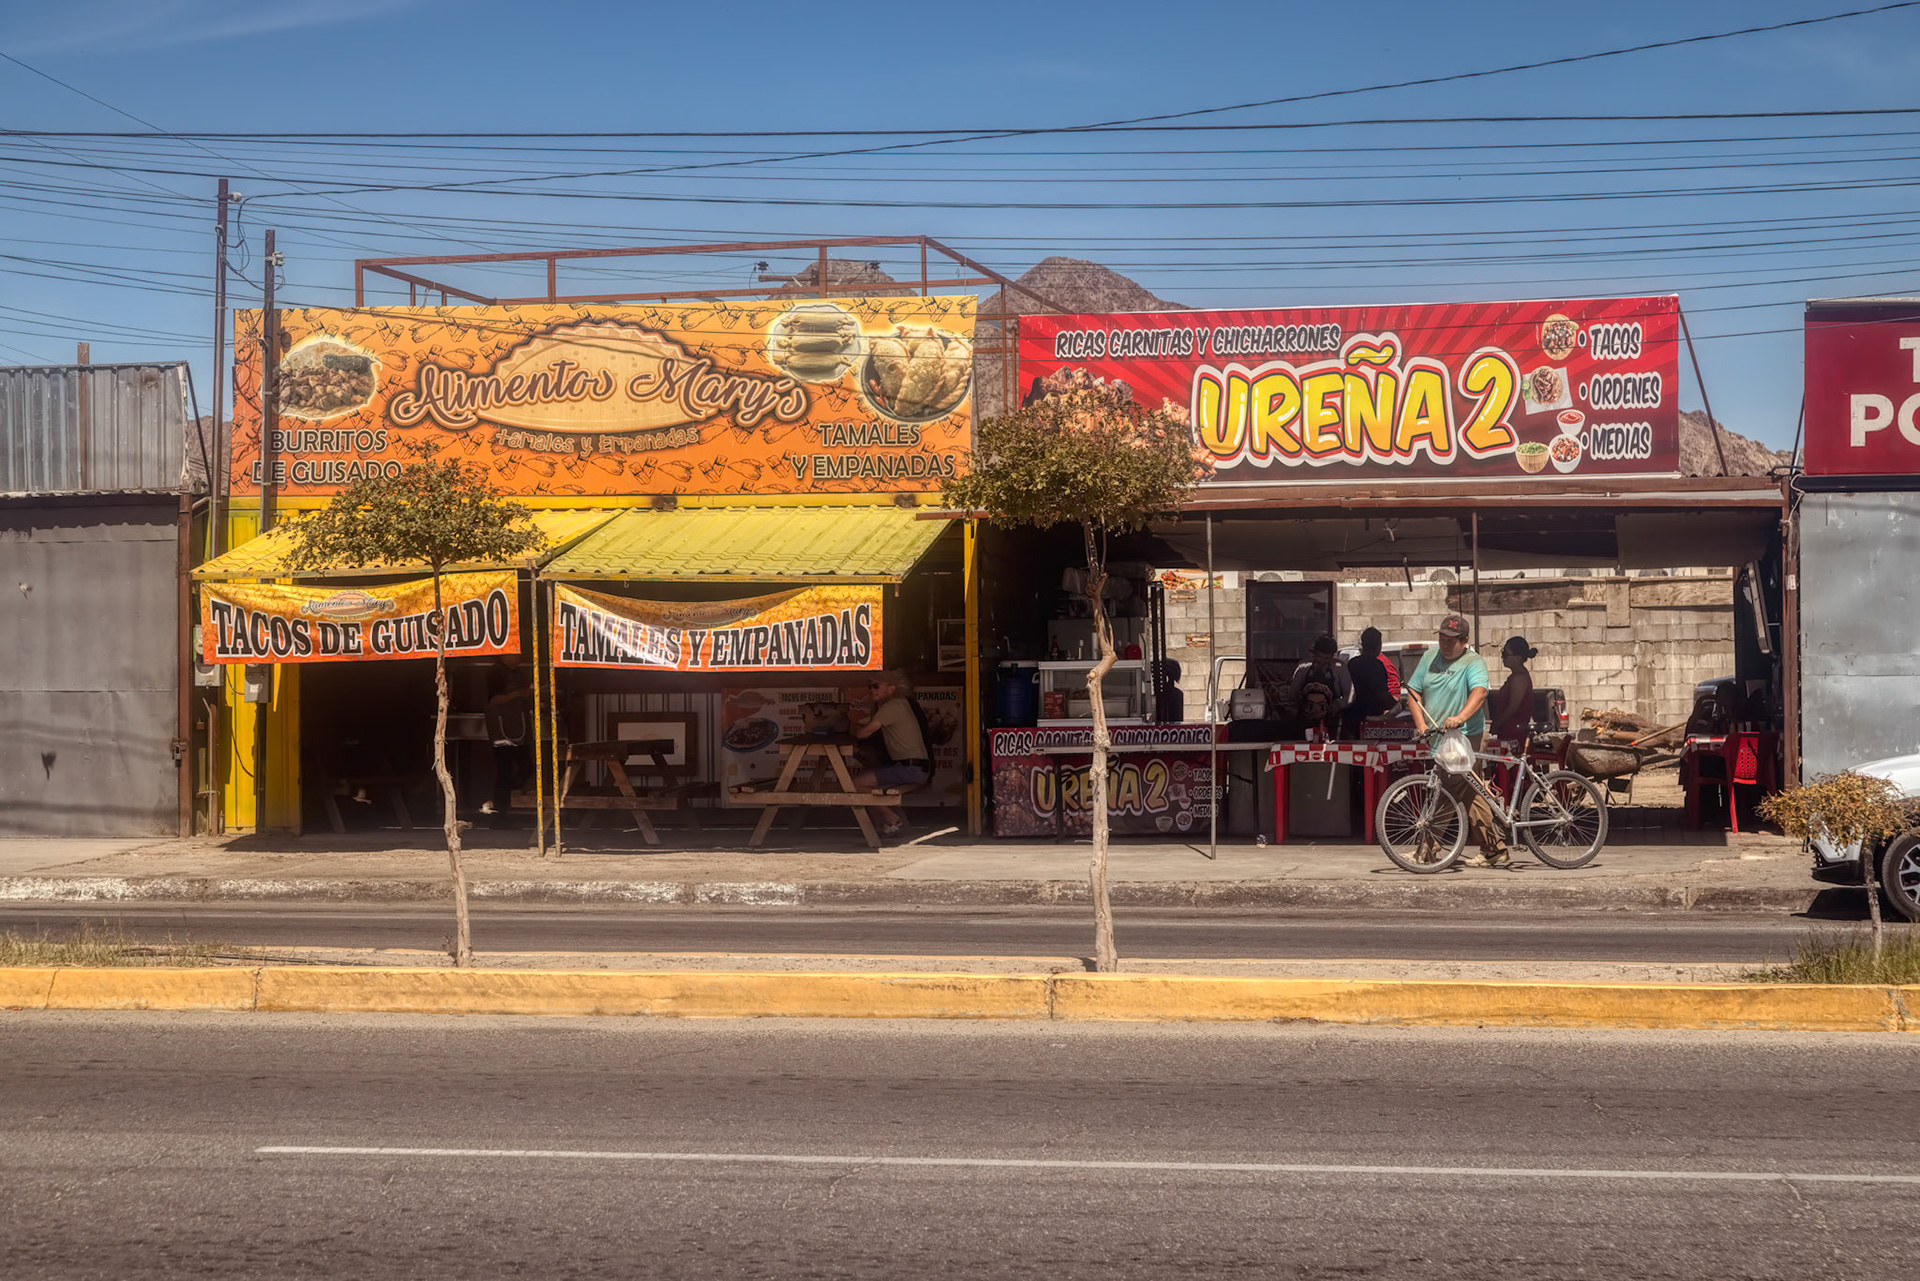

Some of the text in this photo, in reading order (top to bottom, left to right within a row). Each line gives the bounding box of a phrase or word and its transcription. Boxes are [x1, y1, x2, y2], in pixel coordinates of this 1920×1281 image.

[1055, 323, 1342, 359] RICAS CARNITAS Y CHICHARRONES
[1590, 322, 1643, 360] TACOS
[391, 357, 807, 428] Alimentos Mary's
[1194, 336, 1521, 466] UREÑA 2
[1589, 371, 1662, 410] ORDENES
[271, 429, 387, 453] BURRITOS
[496, 427, 699, 457] tamales y Empanadas
[819, 423, 921, 447] TAMALES
[1590, 421, 1653, 460] MEDIAS
[291, 459, 403, 484] GUISADO
[791, 453, 956, 479] Y EMPANADAS
[210, 588, 509, 658] TACOS DE GUISADO
[559, 600, 872, 668] TAMALES Y EMPANADAS
[993, 731, 1033, 757] RICAS
[1034, 730, 1095, 748] CARNITA
[1144, 758, 1169, 813] 2
[1193, 786, 1224, 800] ORDEES
[1193, 804, 1220, 818] MEDIS
